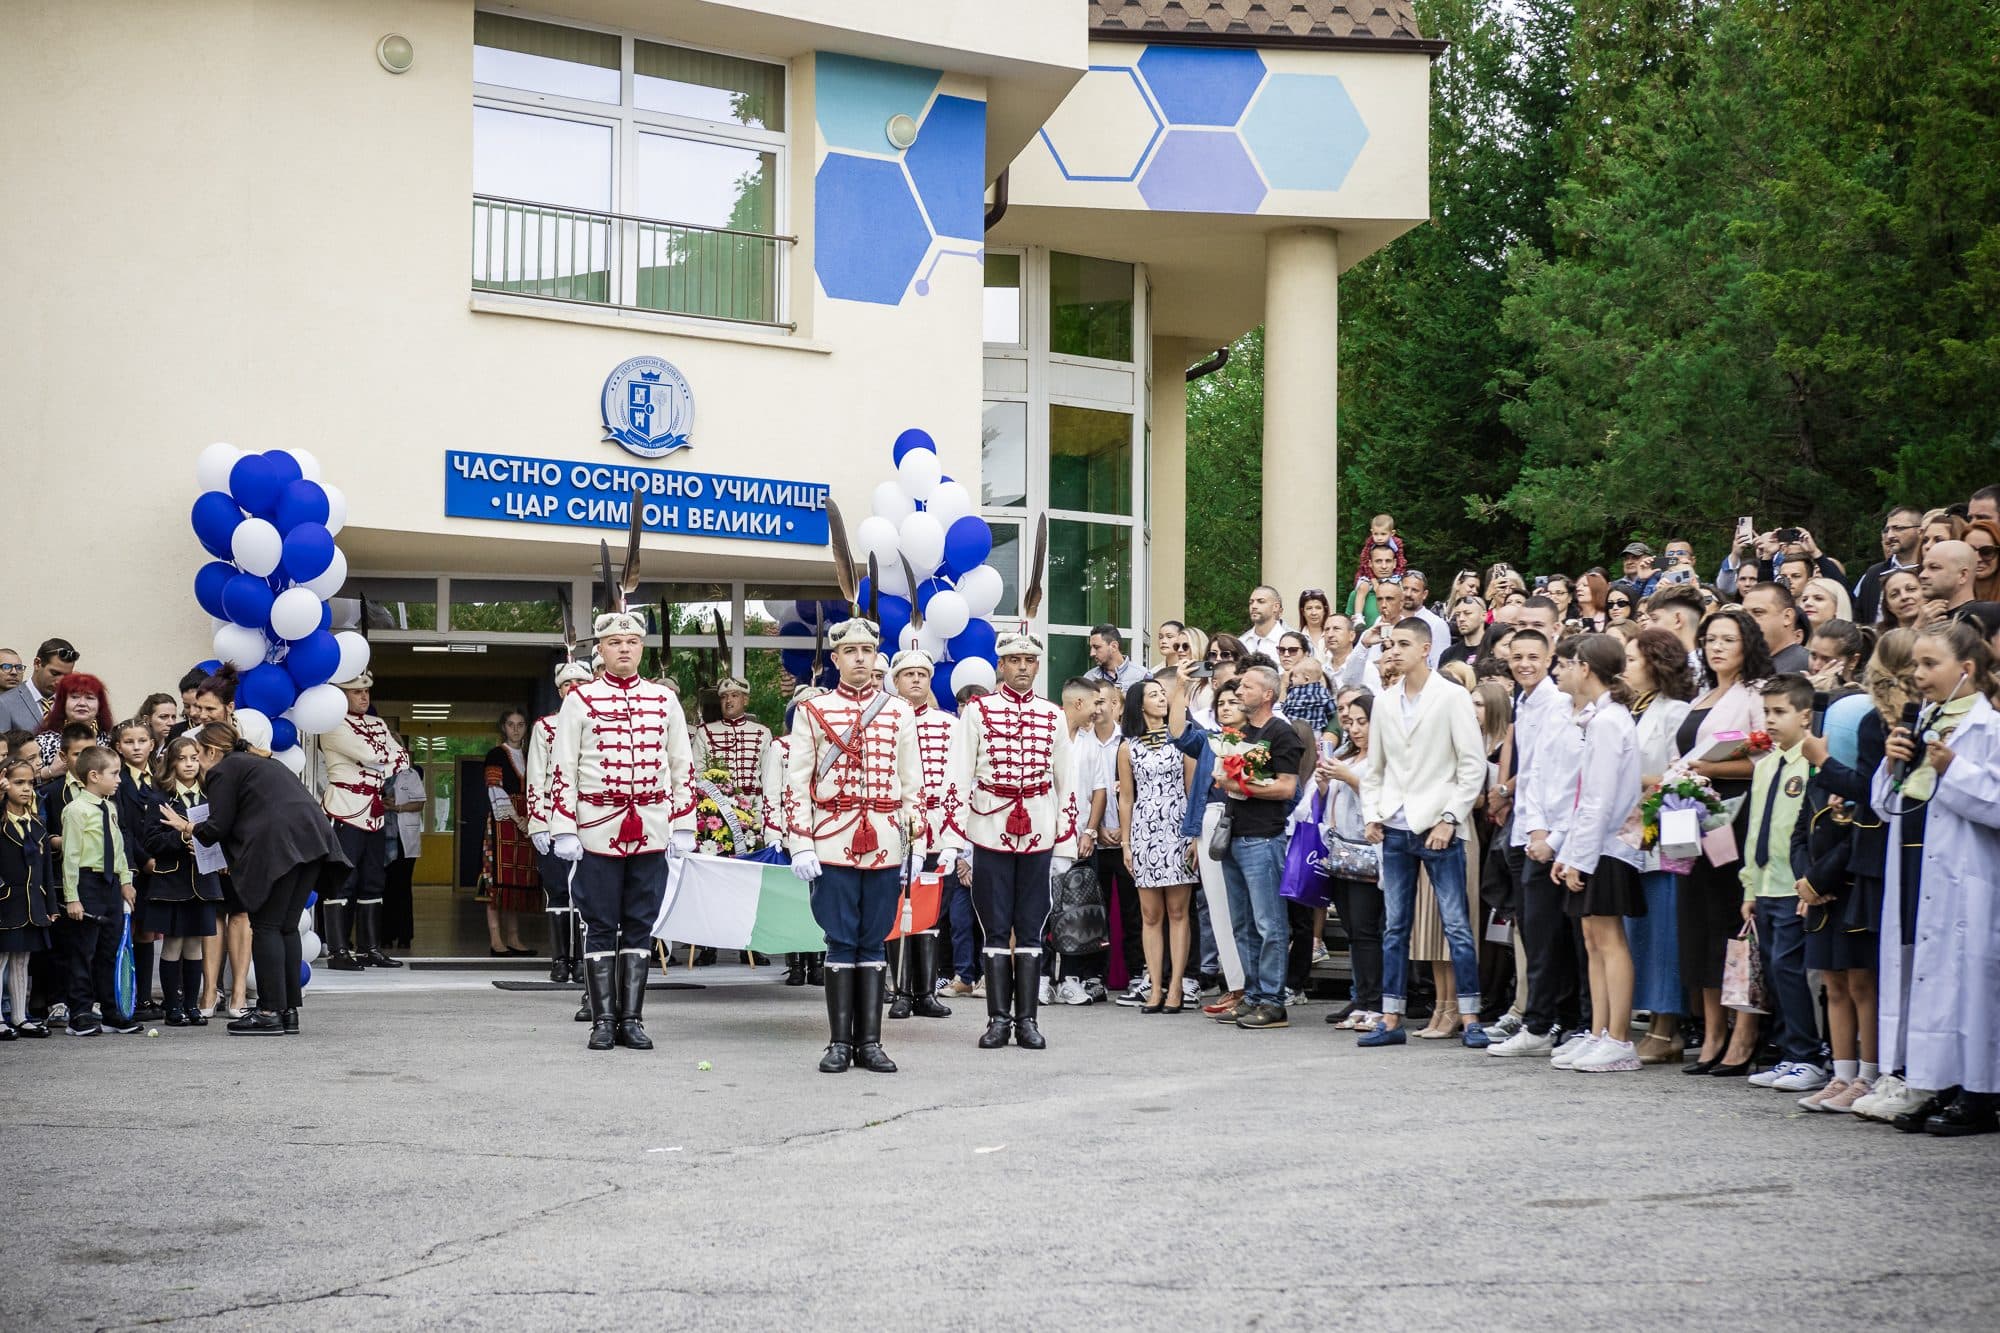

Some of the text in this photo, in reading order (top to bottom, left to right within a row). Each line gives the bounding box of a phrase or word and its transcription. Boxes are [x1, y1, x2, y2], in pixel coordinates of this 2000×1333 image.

[453, 455, 828, 511] ЧАСТНО ОСНОВНО УЧИЛИЩЕ
[506, 492, 781, 535] ЦАР СИМОН ВЕЛИКИ
